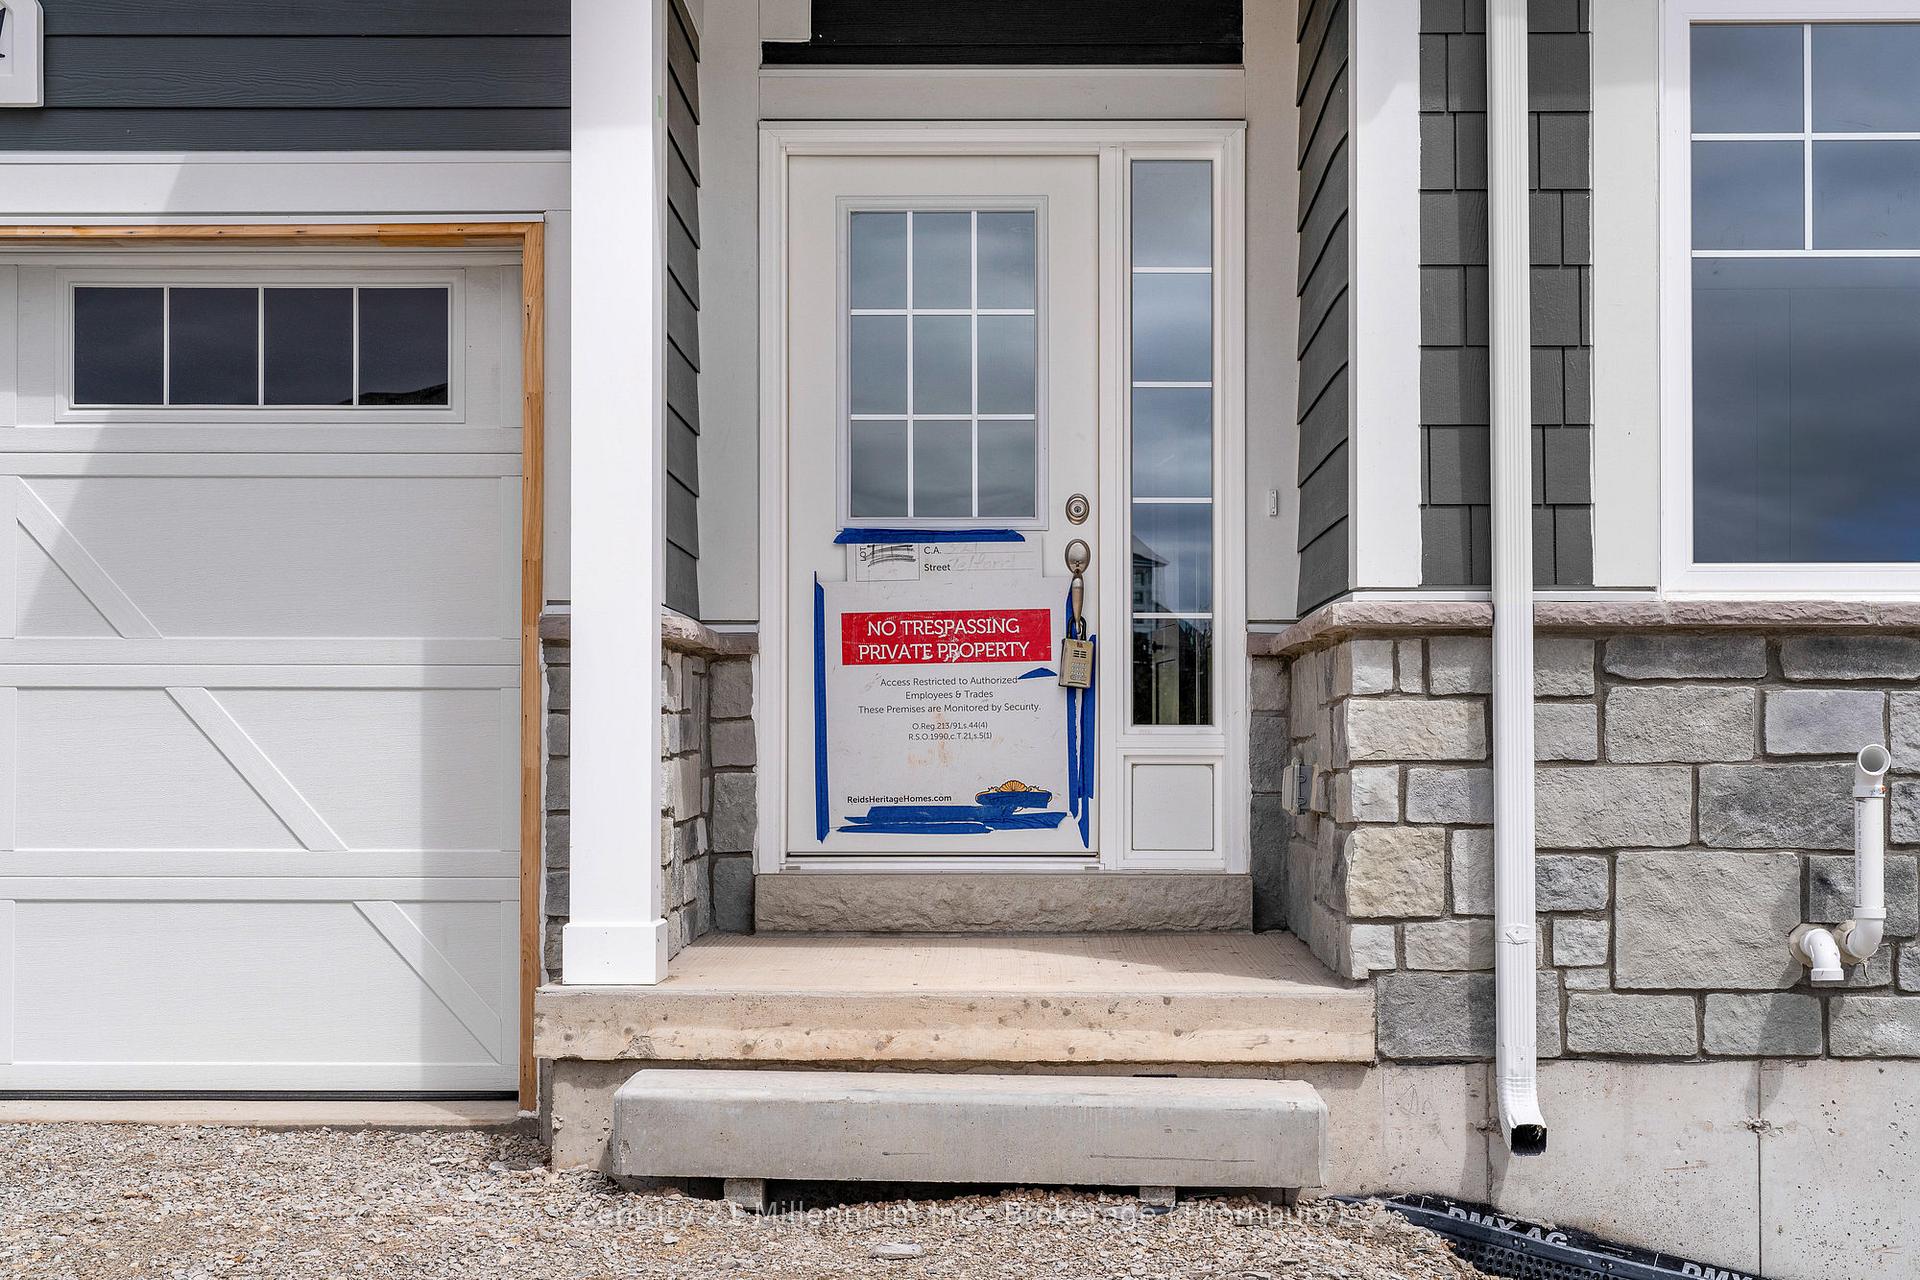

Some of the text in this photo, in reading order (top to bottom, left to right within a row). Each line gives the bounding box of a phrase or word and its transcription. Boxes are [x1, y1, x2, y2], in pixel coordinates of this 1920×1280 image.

[923, 545, 942, 555] C.A.
[924, 563, 951, 571] Street
[867, 618, 1020, 637] NO TRESPASSING
[858, 641, 1030, 661] PRIVATE PROPERTY
[880, 675, 1018, 687] Access Restricted to Authorized
[905, 691, 953, 701] Employees
[965, 690, 994, 698] Trades
[858, 702, 1042, 714] These Premises are Monitored by Security.
[847, 795, 952, 804] ReidsHeritageHomes.com
